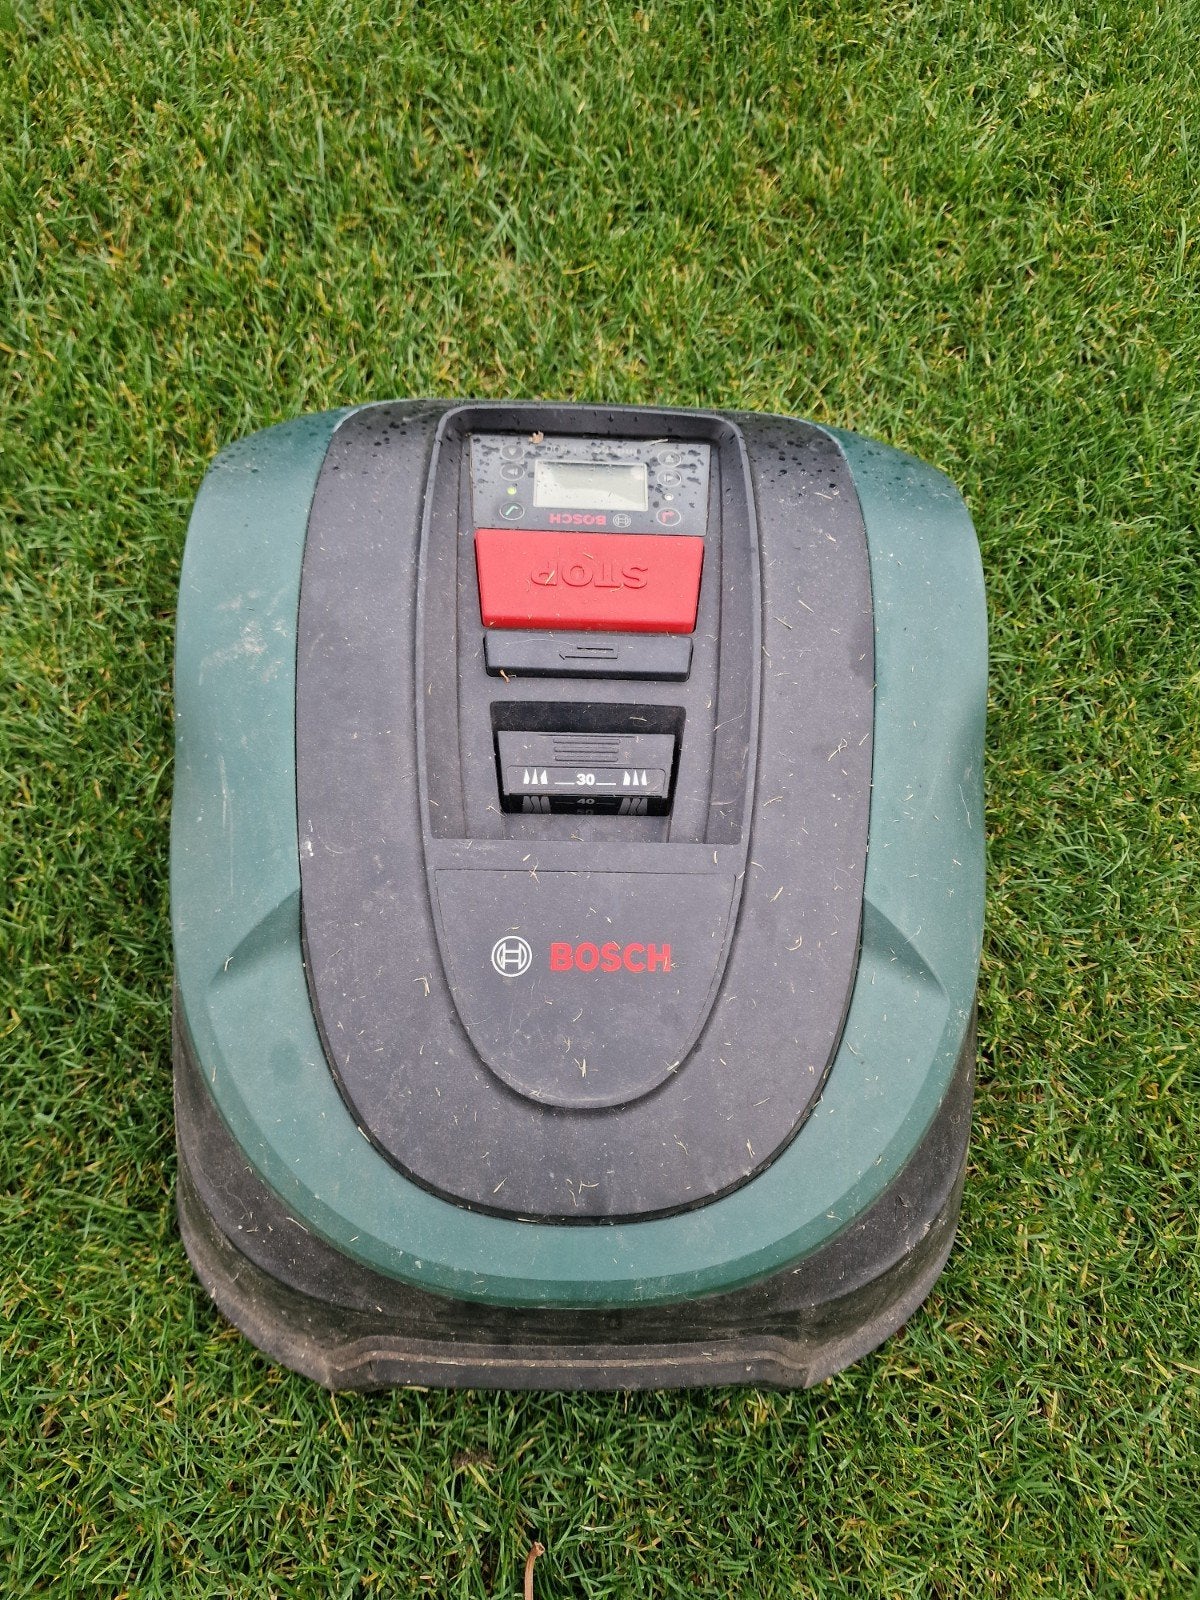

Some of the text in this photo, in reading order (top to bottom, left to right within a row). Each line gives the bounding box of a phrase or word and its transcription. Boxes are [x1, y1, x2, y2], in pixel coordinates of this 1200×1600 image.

[550, 513, 606, 526] BOSCH
[531, 561, 648, 589] STOP
[576, 773, 596, 786] 30
[576, 797, 595, 805] 40
[550, 942, 672, 973] BOSCH
